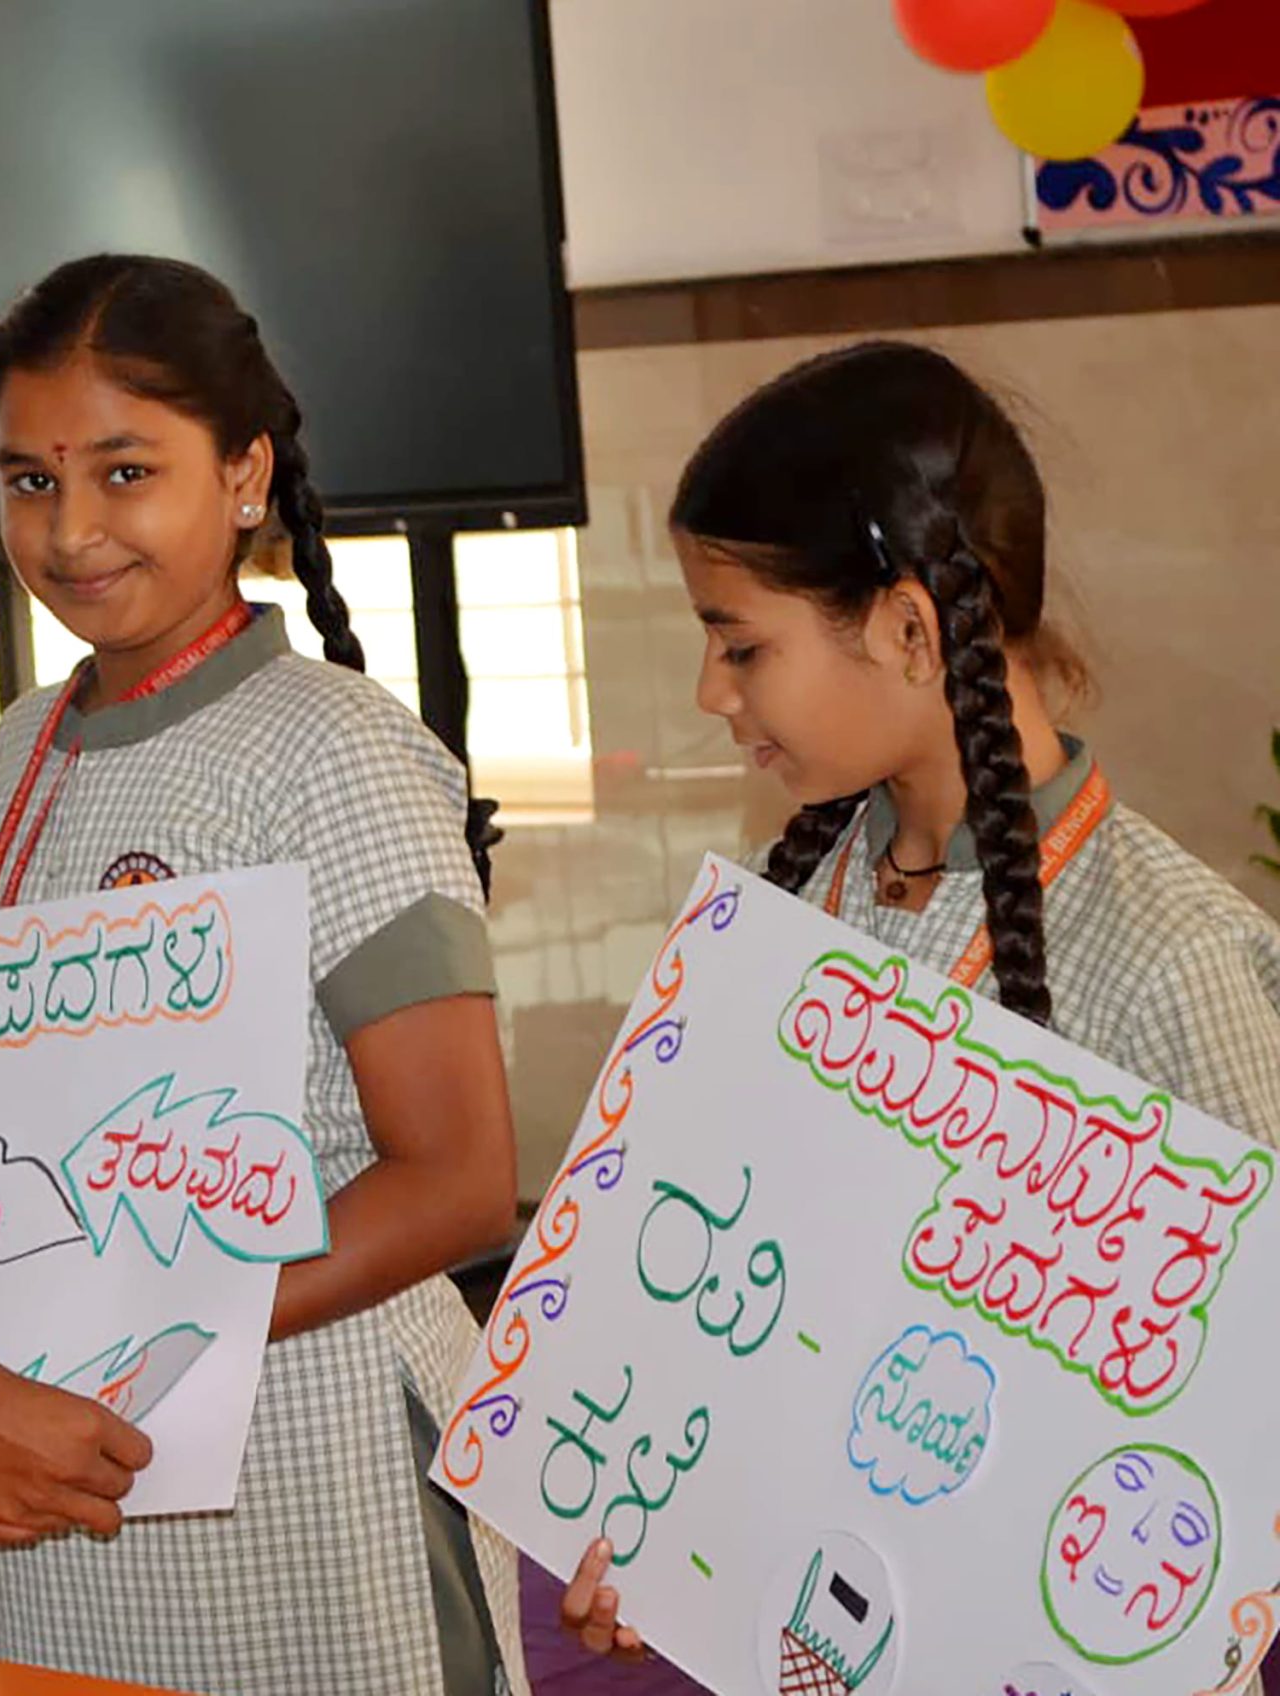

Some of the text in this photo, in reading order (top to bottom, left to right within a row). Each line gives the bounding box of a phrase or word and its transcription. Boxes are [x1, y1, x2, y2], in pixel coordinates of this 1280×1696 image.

[86, 1119, 296, 1226] ತರುವುದು
[794, 964, 1257, 1308] ಸಮಾನಾರ್ಥಕ
[636, 1166, 786, 1357] ರವಿ
[910, 1199, 1180, 1398] ಪದಗಳು
